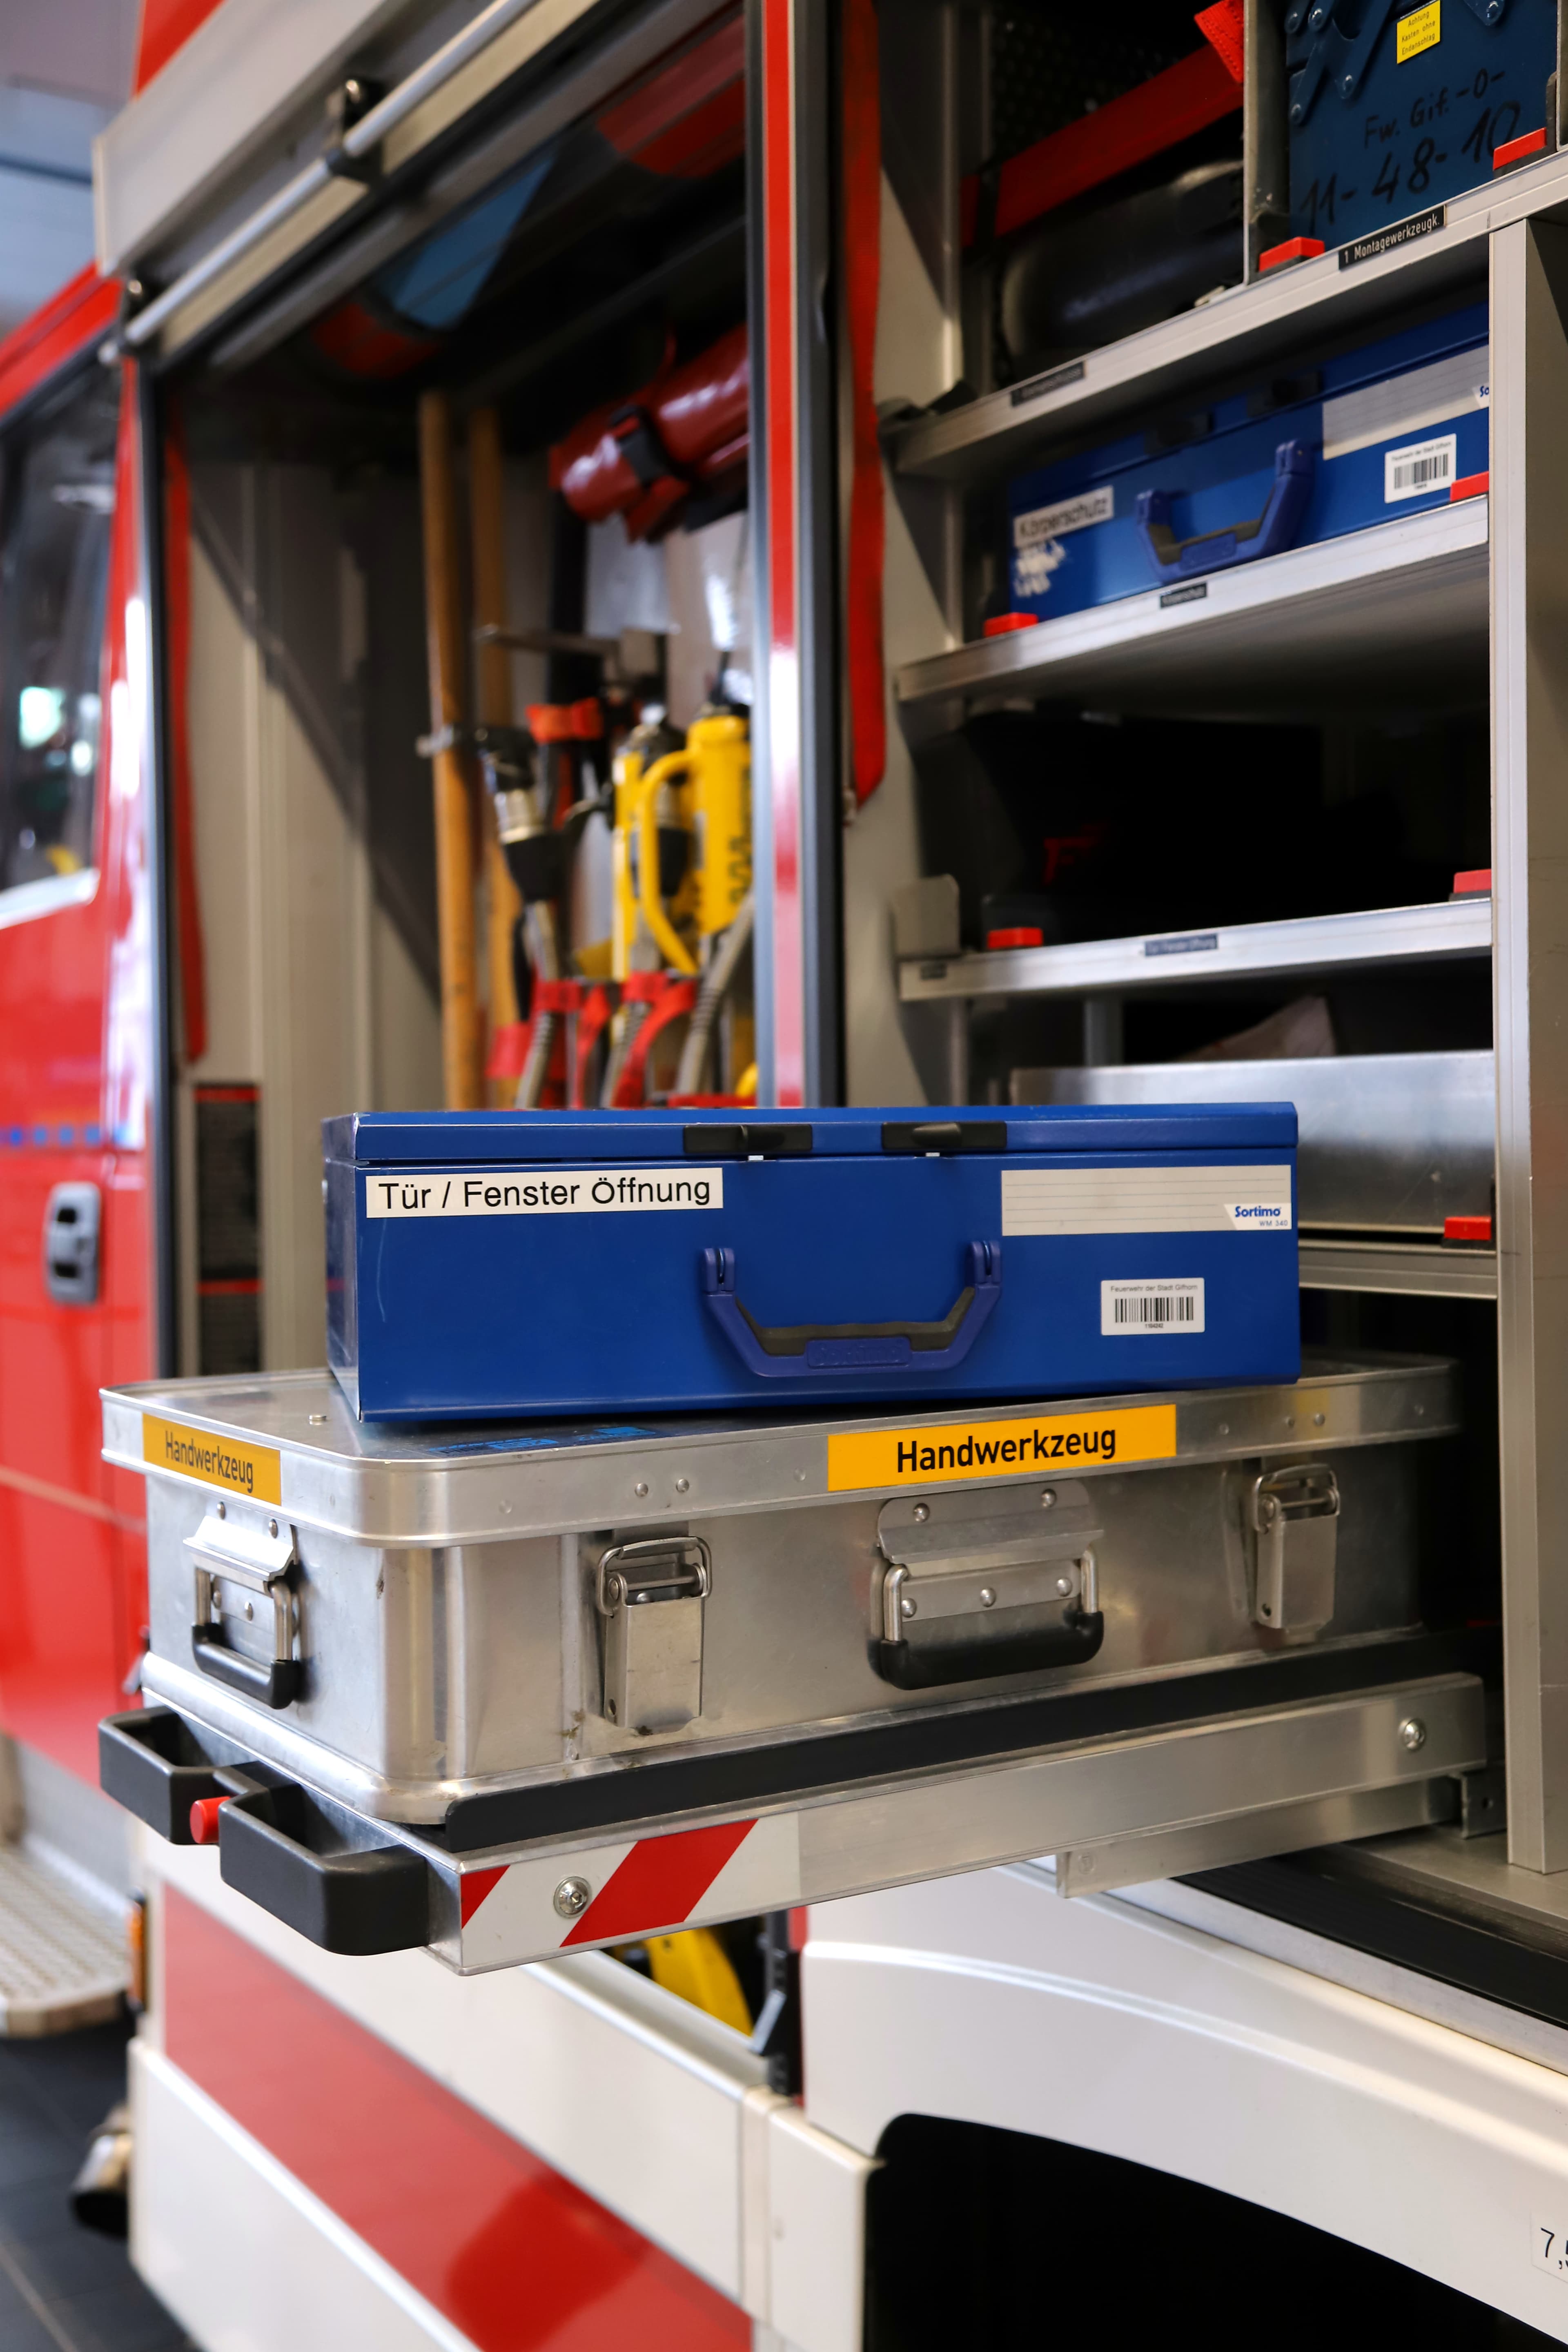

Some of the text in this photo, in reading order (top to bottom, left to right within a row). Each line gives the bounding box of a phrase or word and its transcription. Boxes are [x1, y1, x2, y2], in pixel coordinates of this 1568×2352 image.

[1401, 20, 1436, 42] Kasten ohne
[1408, 11, 1430, 27] Achtung
[1402, 33, 1435, 55] Endanschlag
[1364, 114, 1400, 149] Fw.
[1344, 213, 1440, 264] 1 Montagewerkzeugk.
[379, 1177, 710, 1209] Tür / Fenster Öffnung
[1235, 1205, 1281, 1218] Sortimo
[165, 1430, 254, 1494] Handwerkzeug
[897, 1429, 1116, 1473] Handwerkzeug
[1540, 2227, 1568, 2270] 7,
